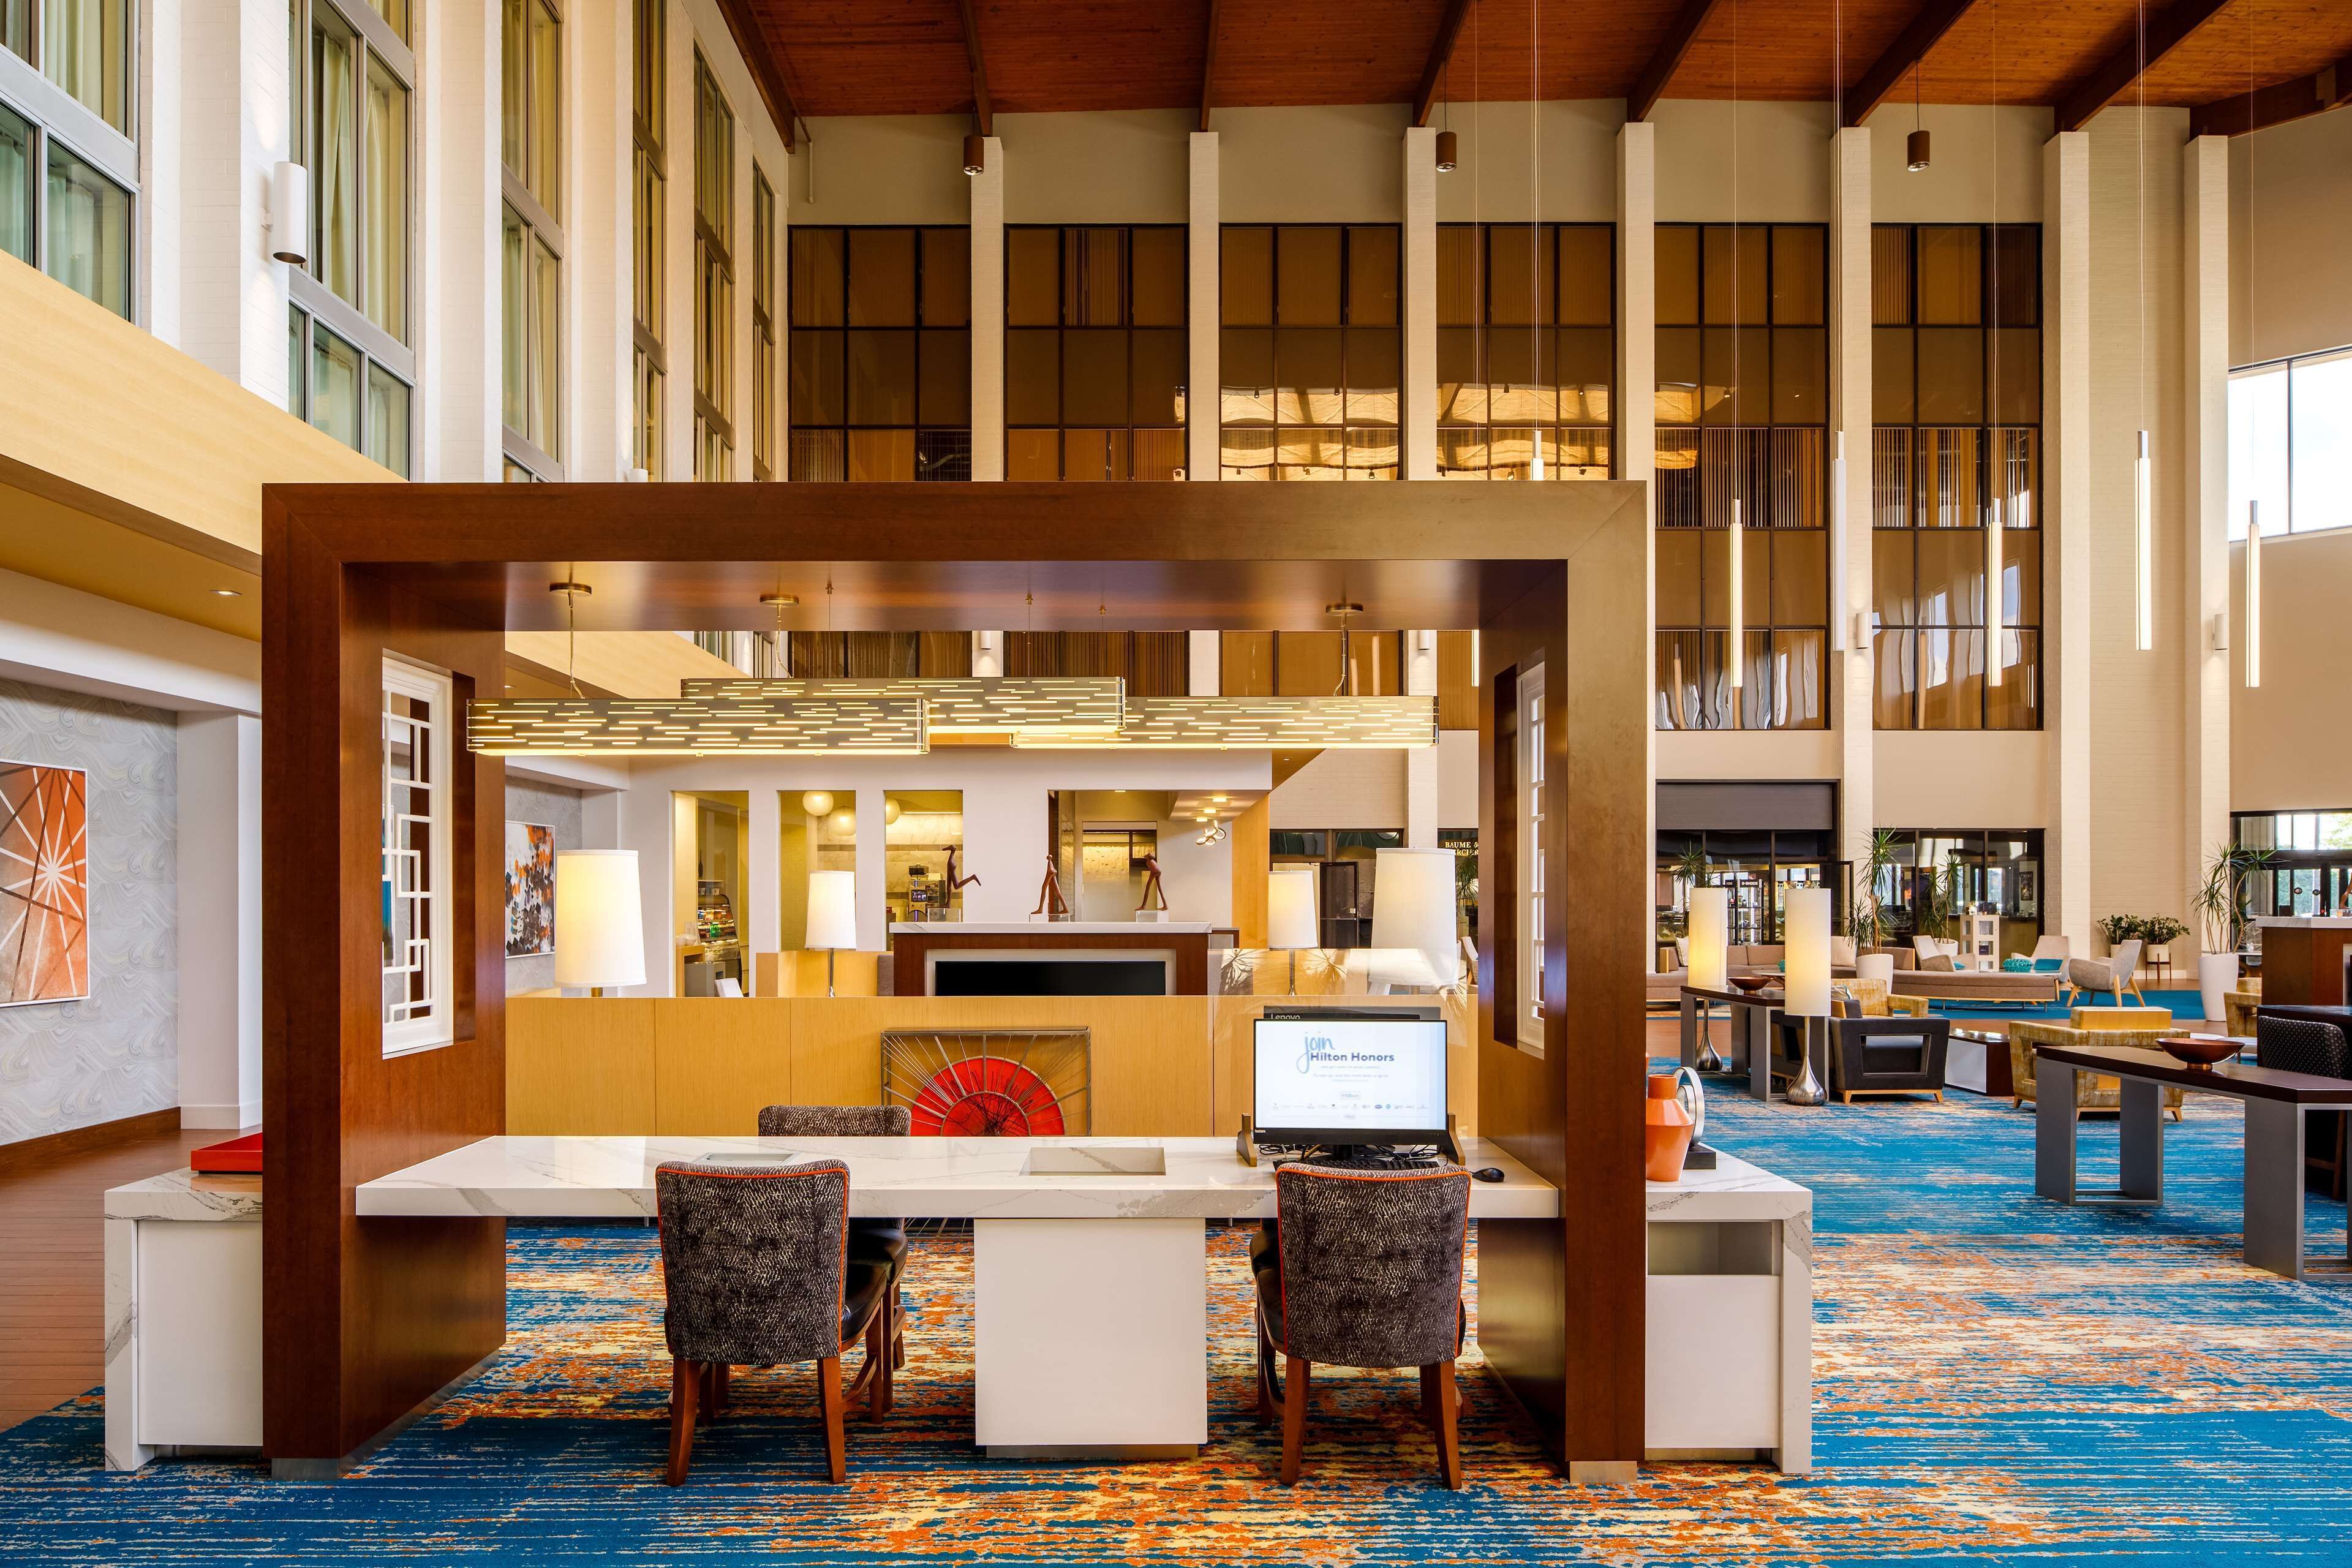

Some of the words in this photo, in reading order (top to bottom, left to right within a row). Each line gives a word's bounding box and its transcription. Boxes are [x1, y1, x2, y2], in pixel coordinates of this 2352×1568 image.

[1296, 1031, 1336, 1074] join
[1310, 1052, 1348, 1061] Hilton
[1351, 1052, 1395, 1061] Honors
